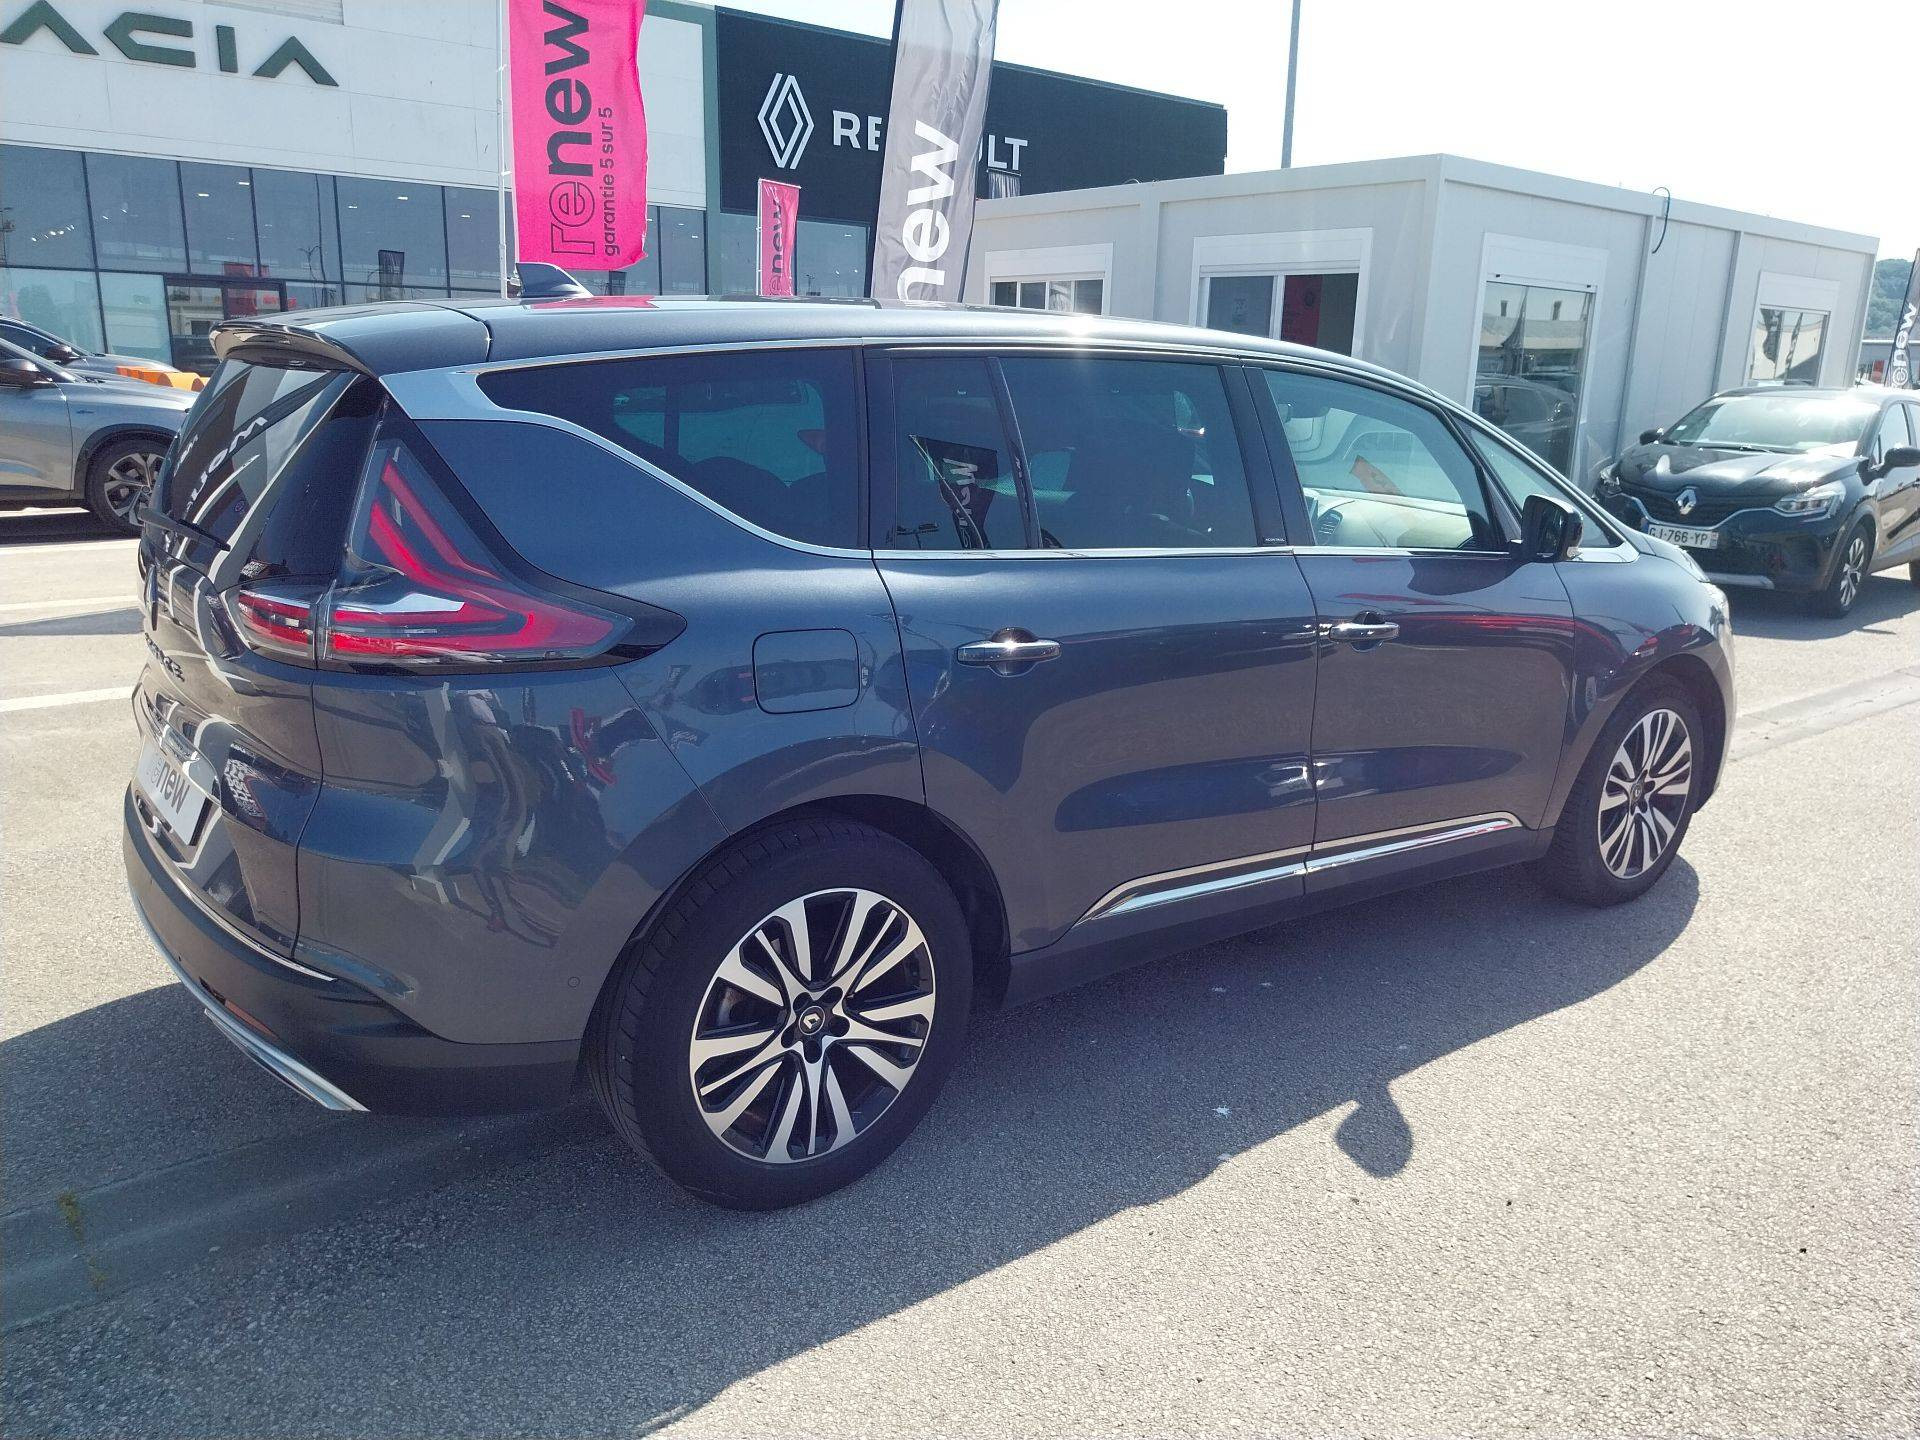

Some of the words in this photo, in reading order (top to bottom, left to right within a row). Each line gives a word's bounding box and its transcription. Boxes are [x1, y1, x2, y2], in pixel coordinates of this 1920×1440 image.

[543, 0, 595, 255] renew
[598, 107, 612, 118] 5
[602, 122, 614, 154] sur
[832, 110, 1028, 171] RELT
[600, 158, 614, 169] 5
[600, 174, 620, 256] garantie
[1892, 302, 1917, 387] enew
